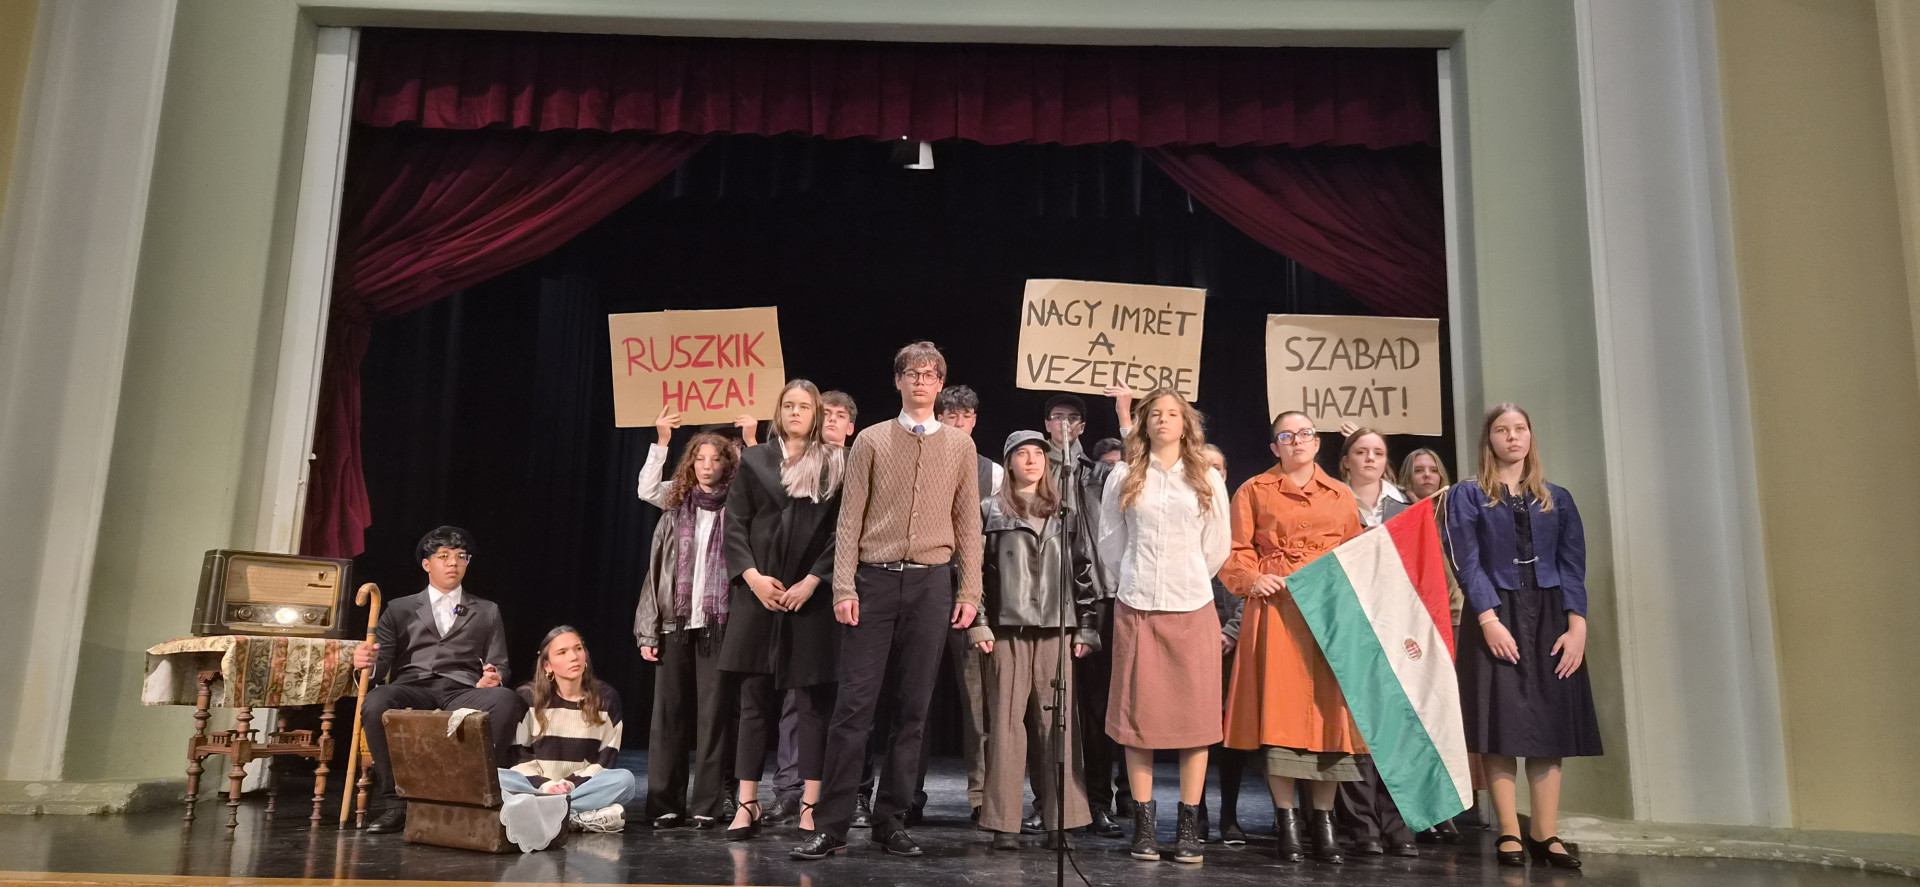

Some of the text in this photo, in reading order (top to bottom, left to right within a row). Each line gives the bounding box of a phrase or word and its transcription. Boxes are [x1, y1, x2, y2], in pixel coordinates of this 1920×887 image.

[1026, 298, 1198, 337] NAGY IMRÉT
[621, 331, 766, 376] RUSZKIK
[1088, 331, 1115, 356] A
[1284, 336, 1420, 372] SZABAD
[662, 372, 756, 413] HAZA!
[1026, 353, 1193, 395] VEZETÉSBE
[1302, 378, 1408, 420] HAZÁT!
